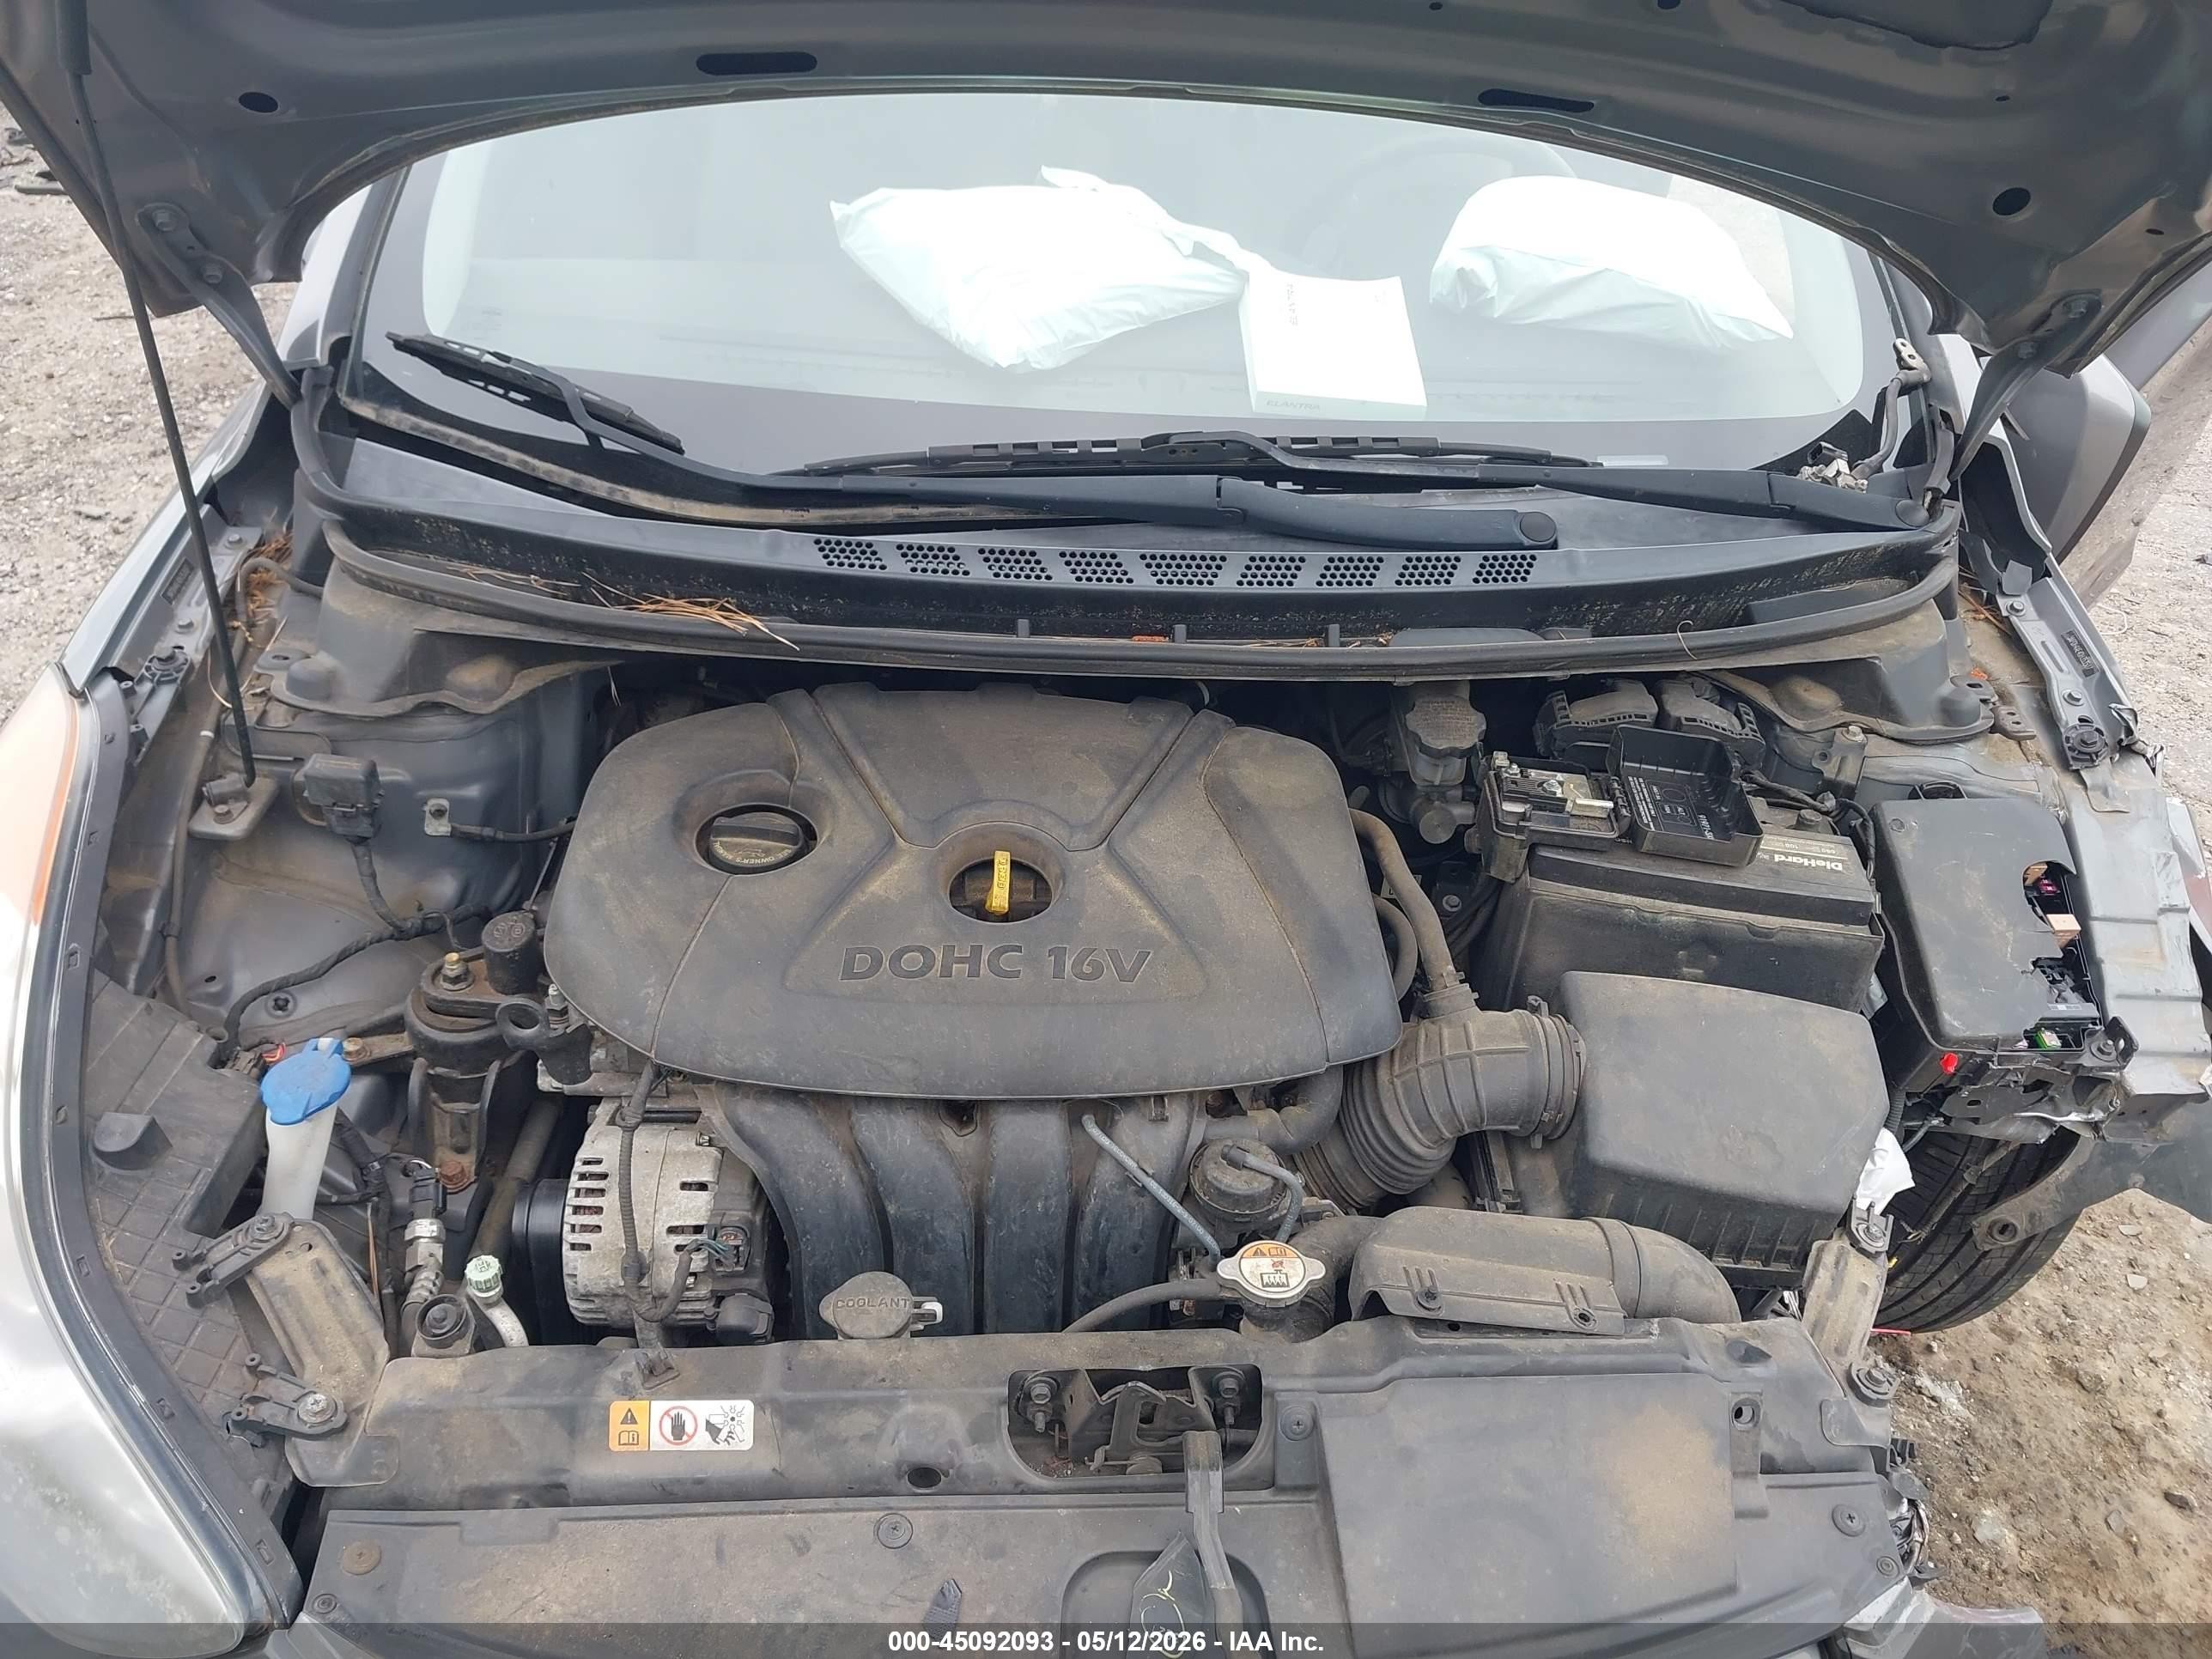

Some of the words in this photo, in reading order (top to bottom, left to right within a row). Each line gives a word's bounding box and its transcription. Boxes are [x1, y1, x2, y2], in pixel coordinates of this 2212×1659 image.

[1266, 399, 1321, 412] ELANTRA
[1774, 854, 1844, 872] DieHard
[839, 944, 1024, 981] DOHC
[1048, 945, 1153, 983] 16V
[836, 1297, 911, 1310] COOLANT
